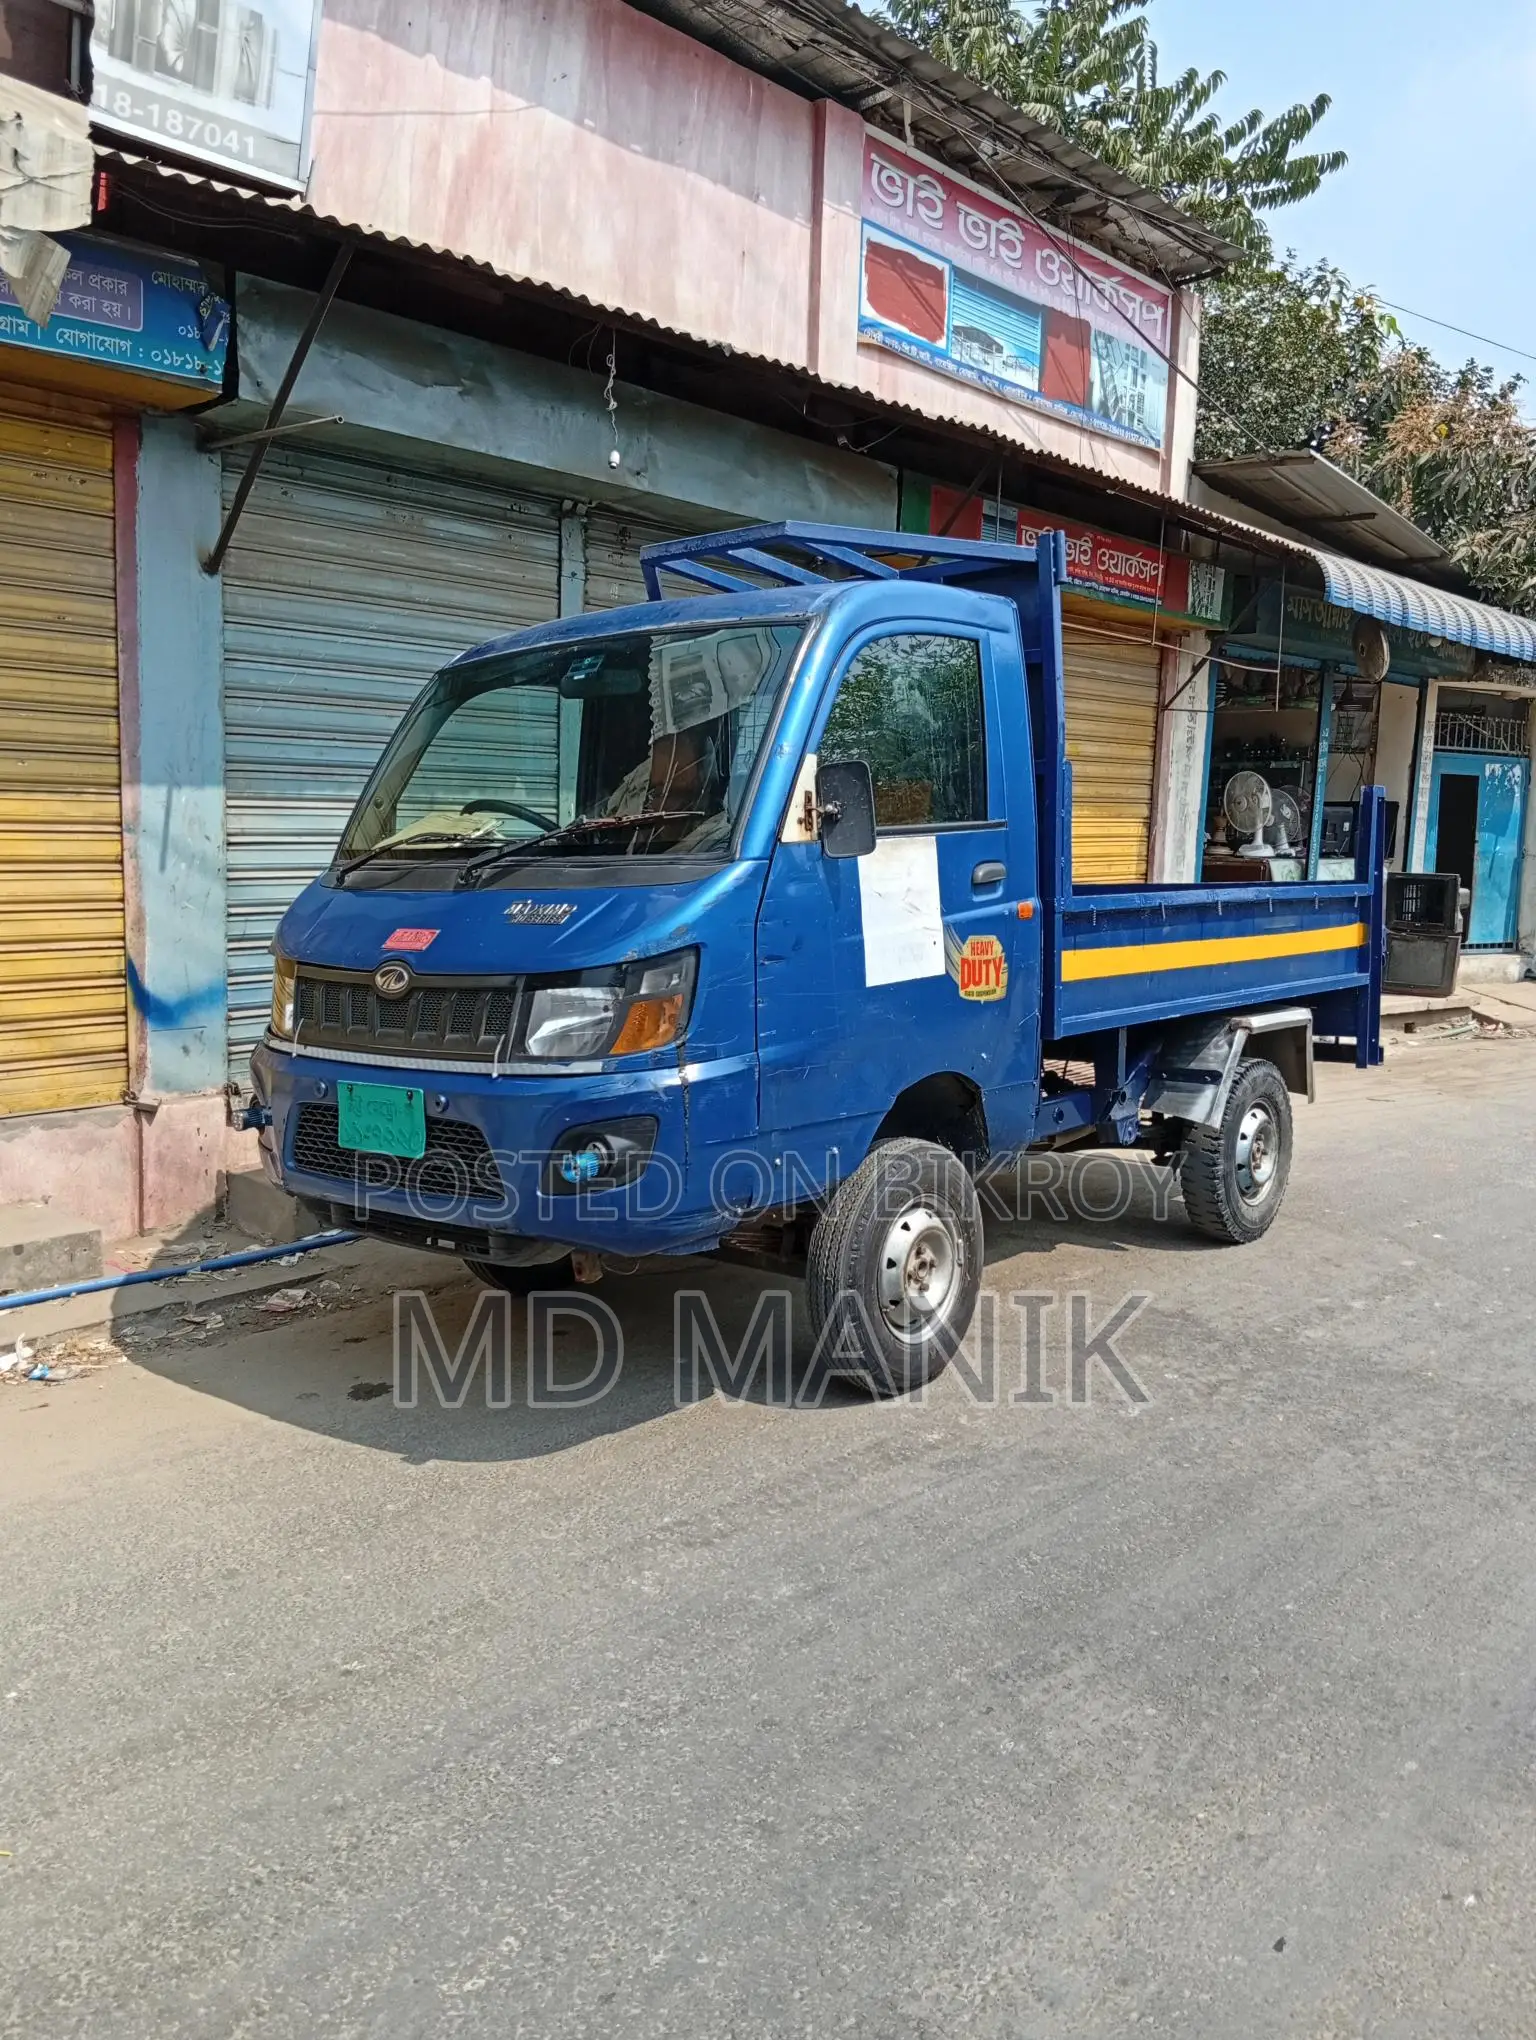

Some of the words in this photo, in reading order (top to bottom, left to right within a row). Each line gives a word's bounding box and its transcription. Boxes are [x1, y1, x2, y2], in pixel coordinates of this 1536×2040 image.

[870, 153, 946, 229] ভাই
[956, 201, 1025, 269] ভাই
[88, 272, 128, 296] প্রকার
[68, 292, 96, 313] করা
[56, 327, 133, 358] যোগাযোগ
[971, 940, 994, 956] HEAVY
[960, 955, 1003, 990] DUTY
